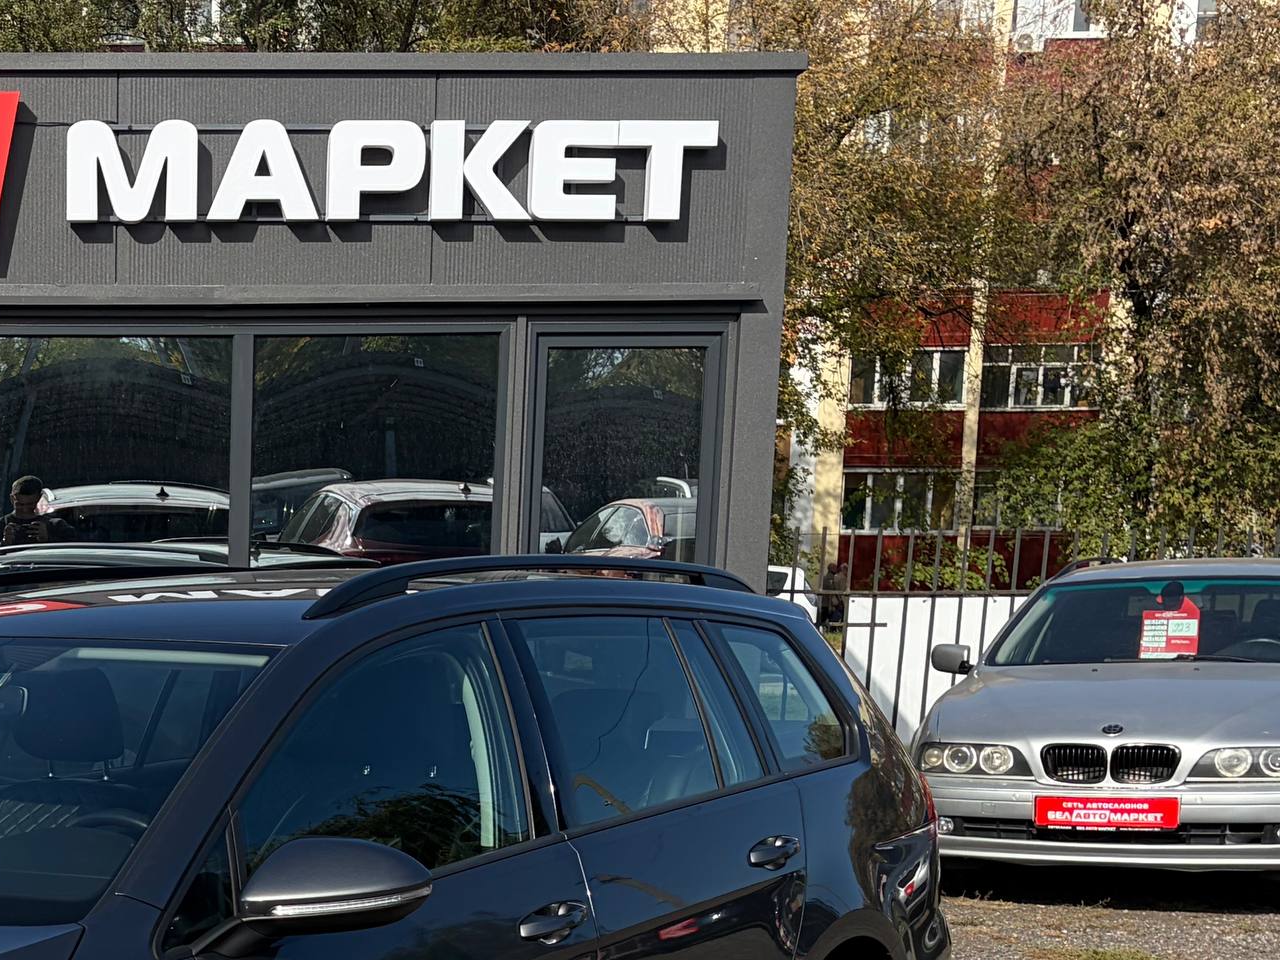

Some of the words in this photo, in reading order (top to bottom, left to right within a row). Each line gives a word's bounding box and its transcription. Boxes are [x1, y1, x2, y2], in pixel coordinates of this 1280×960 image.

[66, 119, 720, 224] МАРКЕТ
[1047, 811, 1071, 821] БЕЛ
[1074, 811, 1108, 820] АВТО
[1109, 812, 1164, 822] МАРКЕТ
